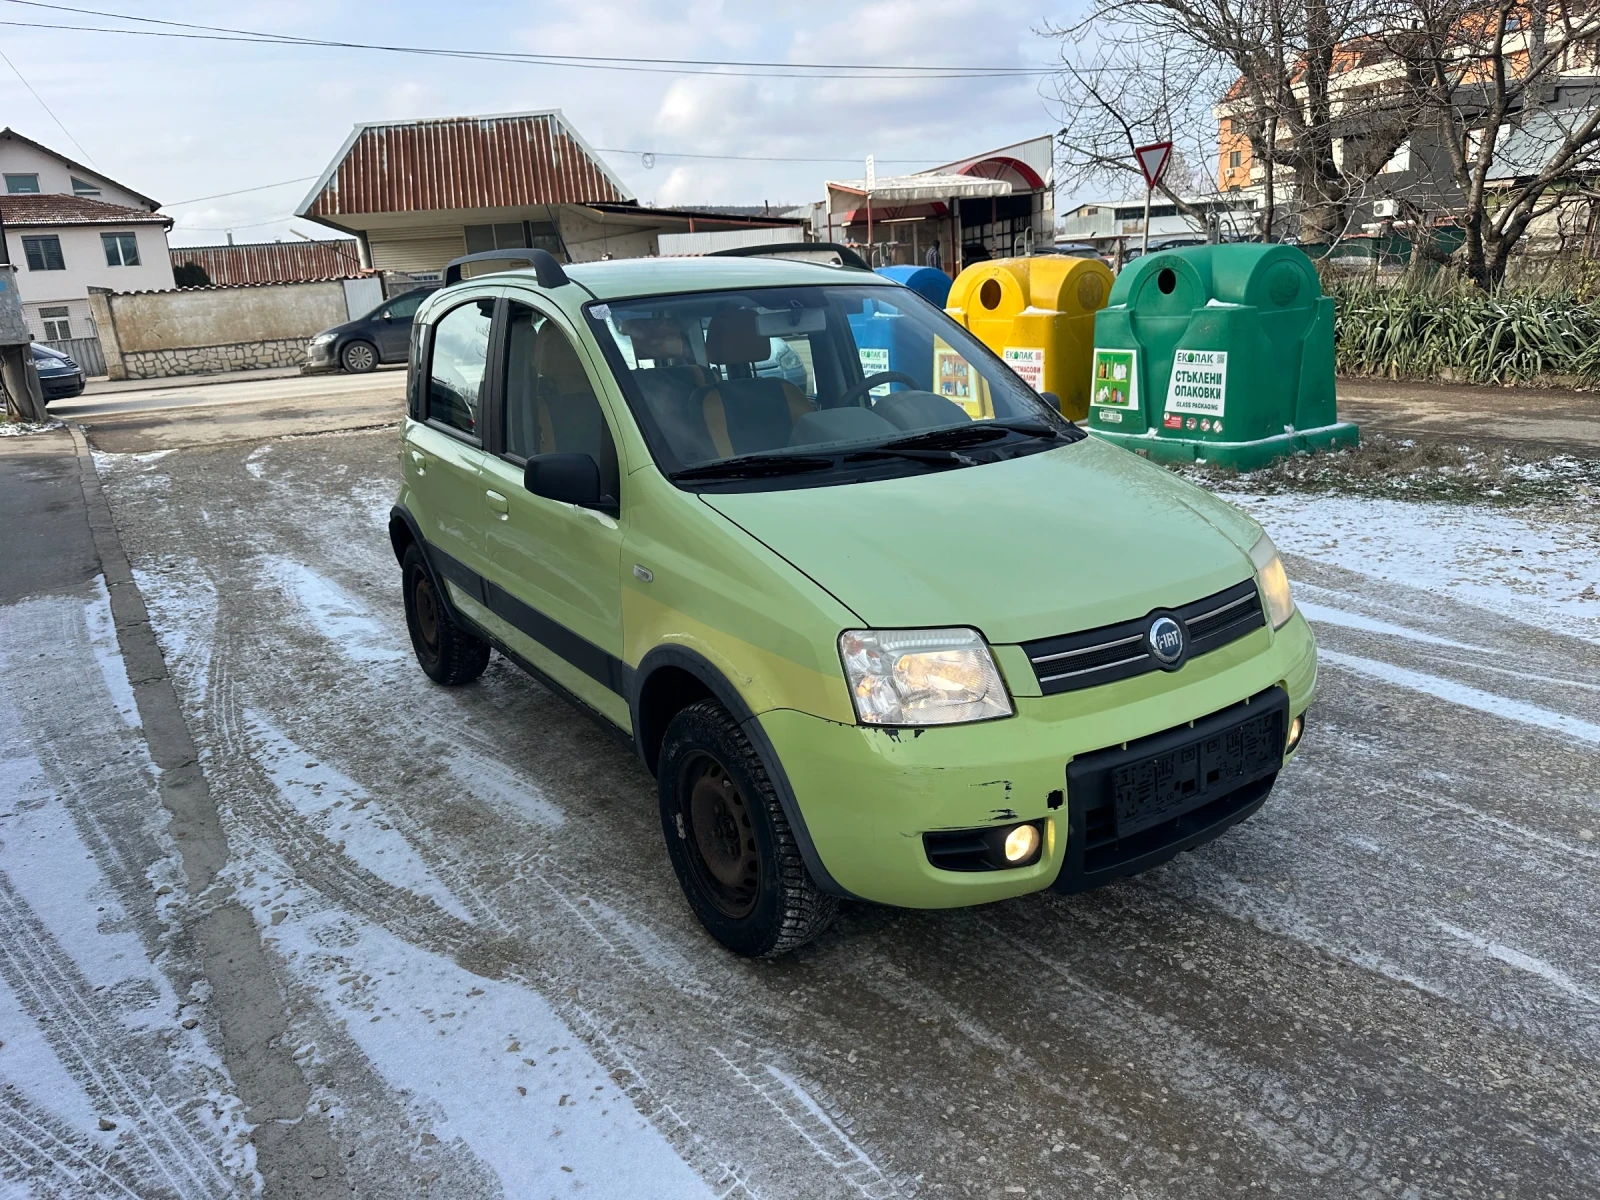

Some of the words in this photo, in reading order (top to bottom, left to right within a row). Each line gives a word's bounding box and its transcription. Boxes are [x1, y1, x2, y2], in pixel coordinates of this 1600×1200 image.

[1177, 352, 1213, 363] ЕКОПАК
[1175, 370, 1222, 385] СТЪКЛЕНИ
[1174, 385, 1221, 399] ОПАКОВКИ
[1192, 402, 1218, 410] PACKAGING
[1157, 630, 1179, 650] FIAT
